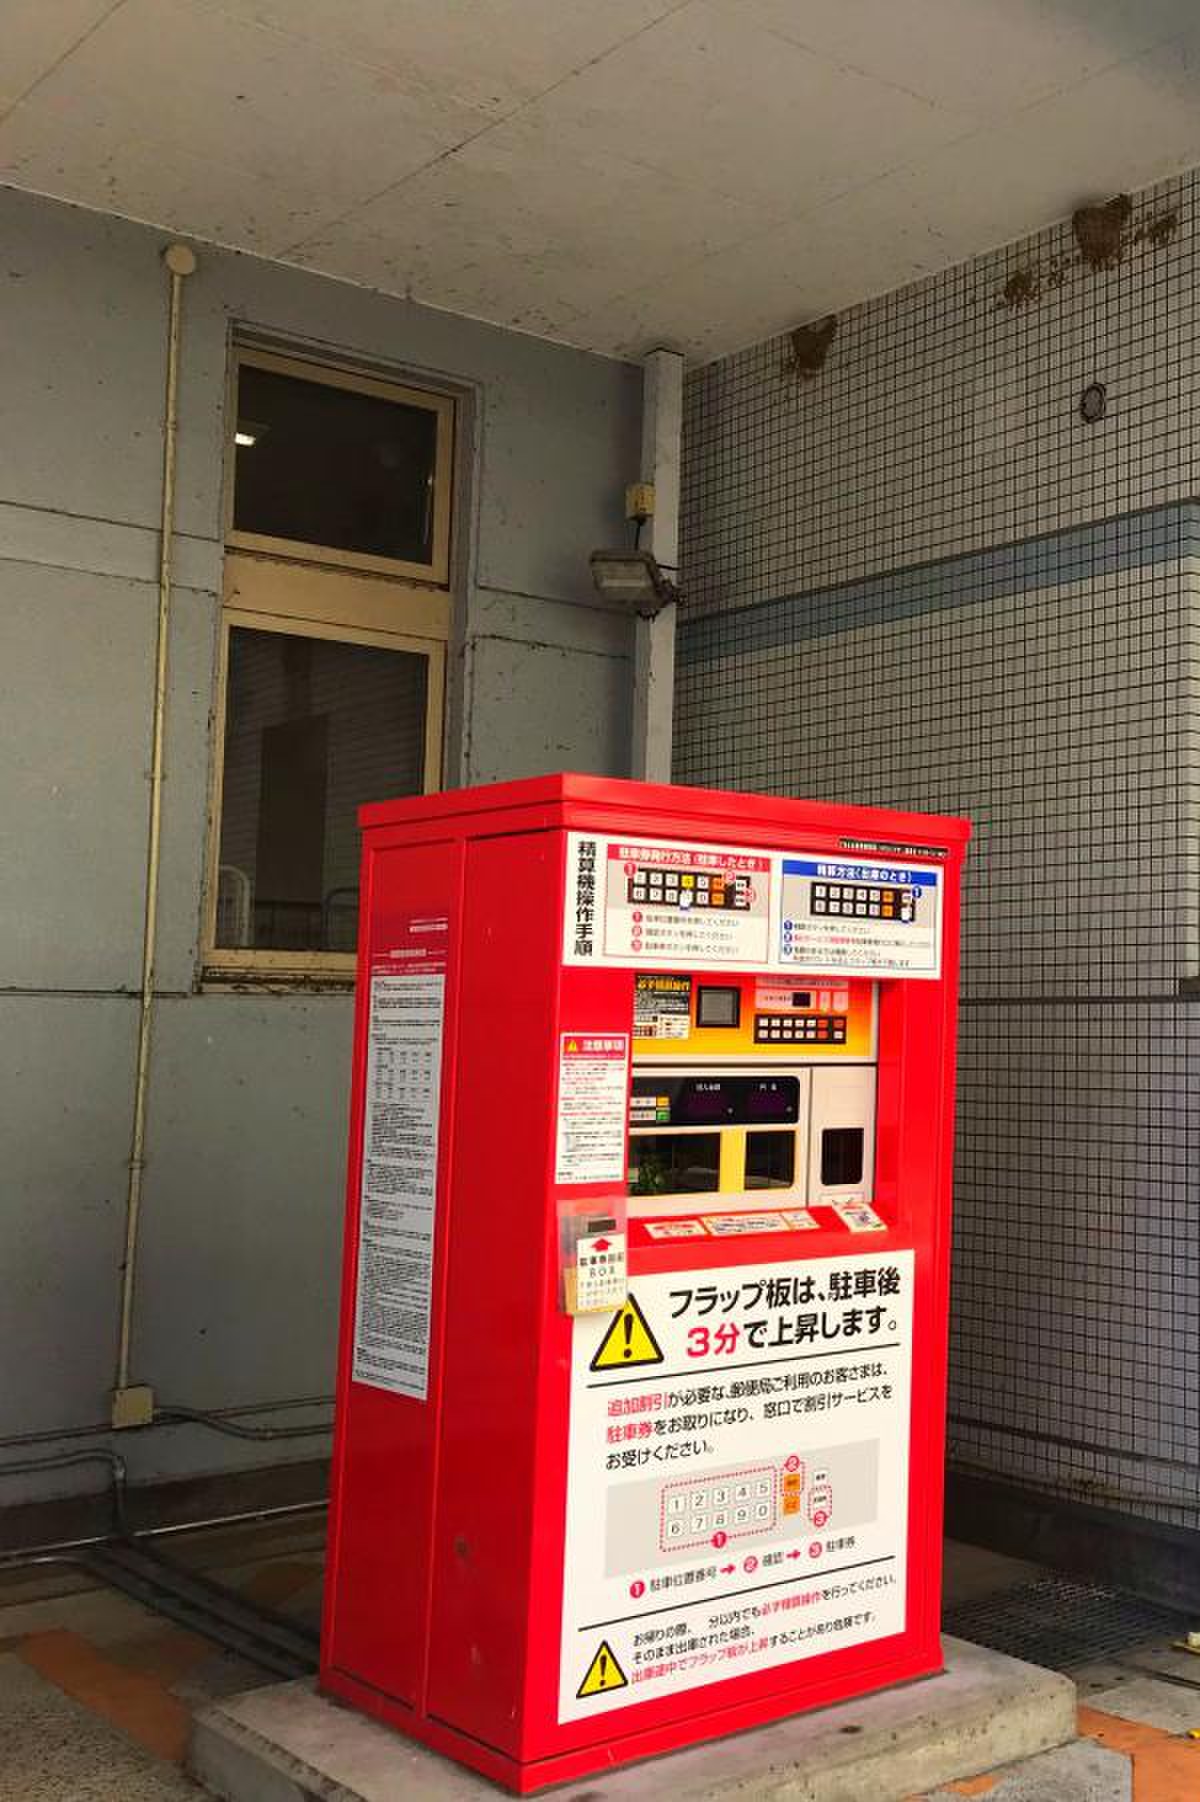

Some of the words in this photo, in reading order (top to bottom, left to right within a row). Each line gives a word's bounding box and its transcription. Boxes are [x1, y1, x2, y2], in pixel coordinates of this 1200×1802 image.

[575, 841, 596, 956] 精算機操作手順
[669, 1266, 900, 1319] フラップ板は、駐車後
[686, 1305, 896, 1358] 3分で上昇します。
